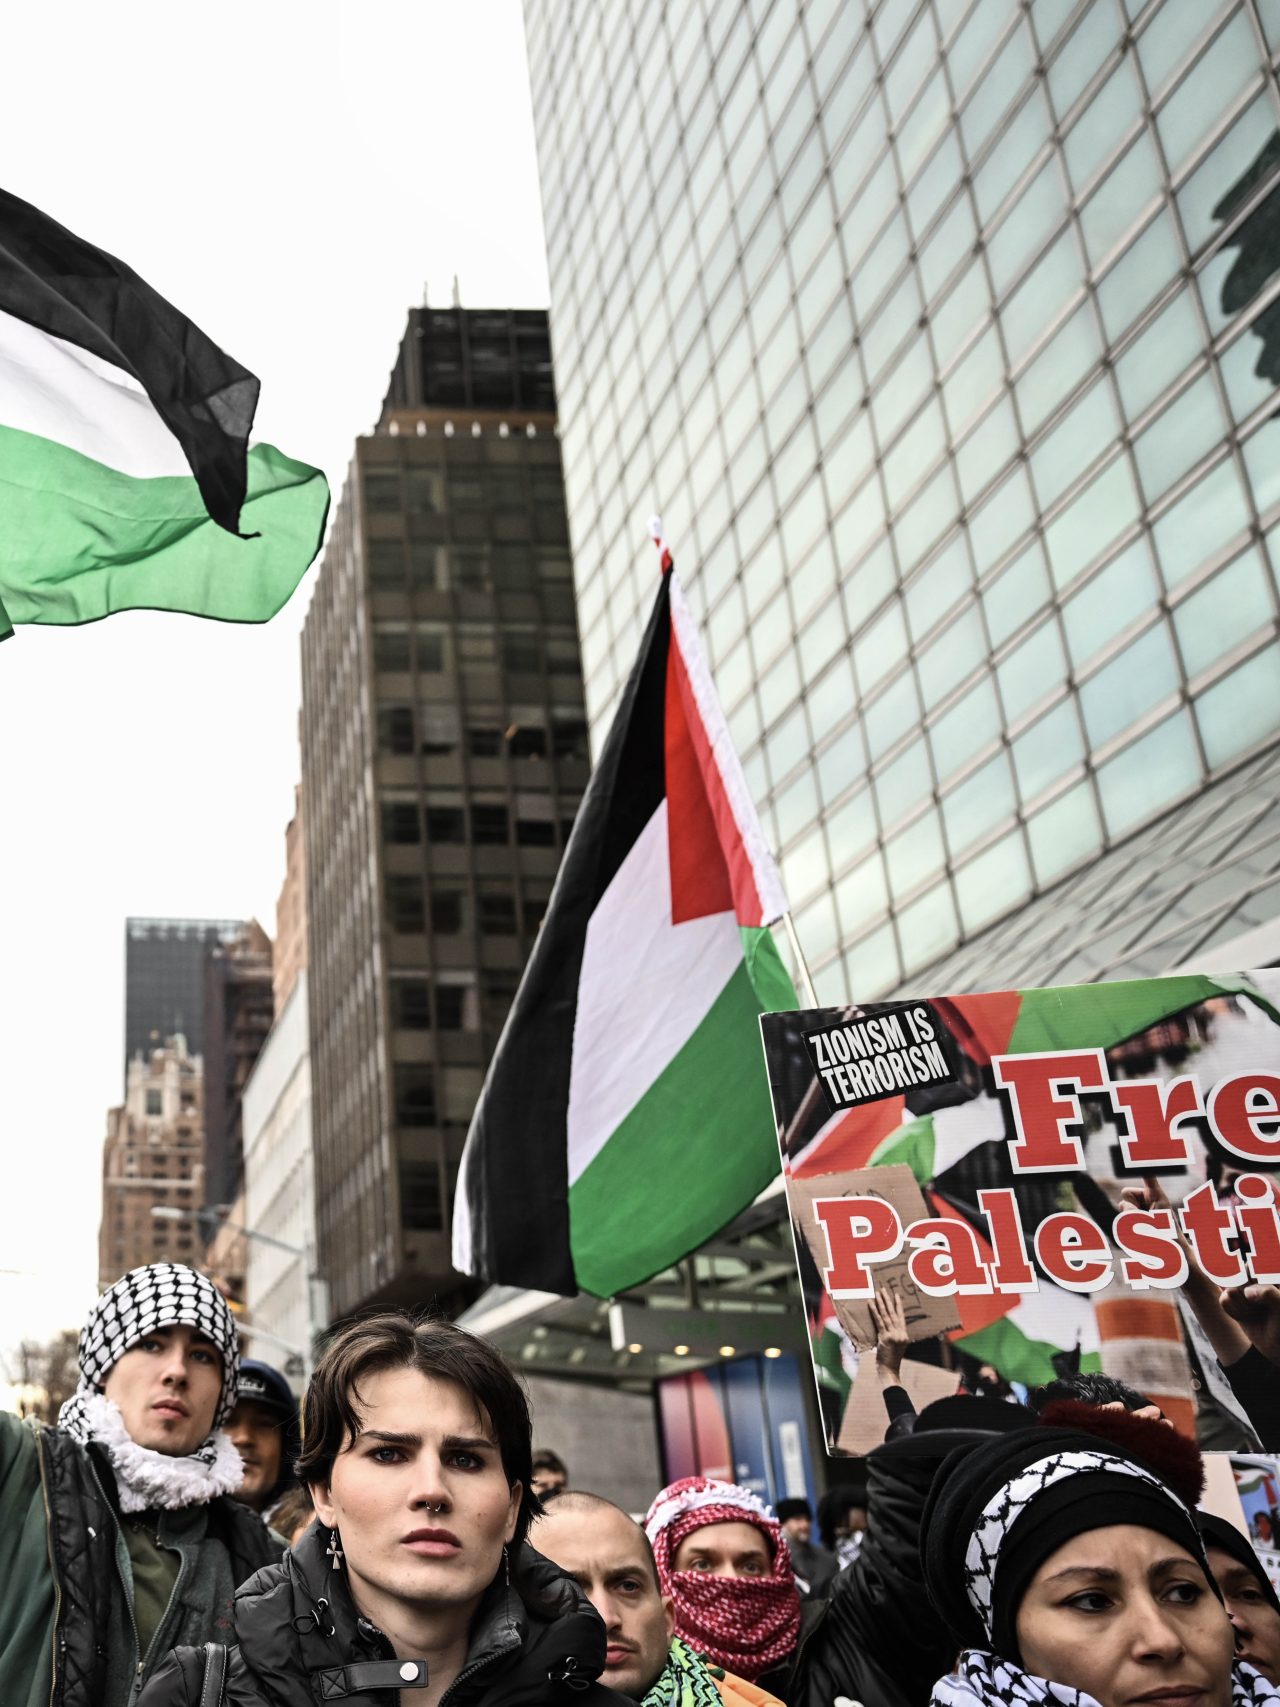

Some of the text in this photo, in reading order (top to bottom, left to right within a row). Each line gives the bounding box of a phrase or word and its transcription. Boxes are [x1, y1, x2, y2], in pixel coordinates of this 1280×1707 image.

[808, 1006, 936, 1070] ZIONISM IS
[819, 1040, 951, 1105] TERRORISM
